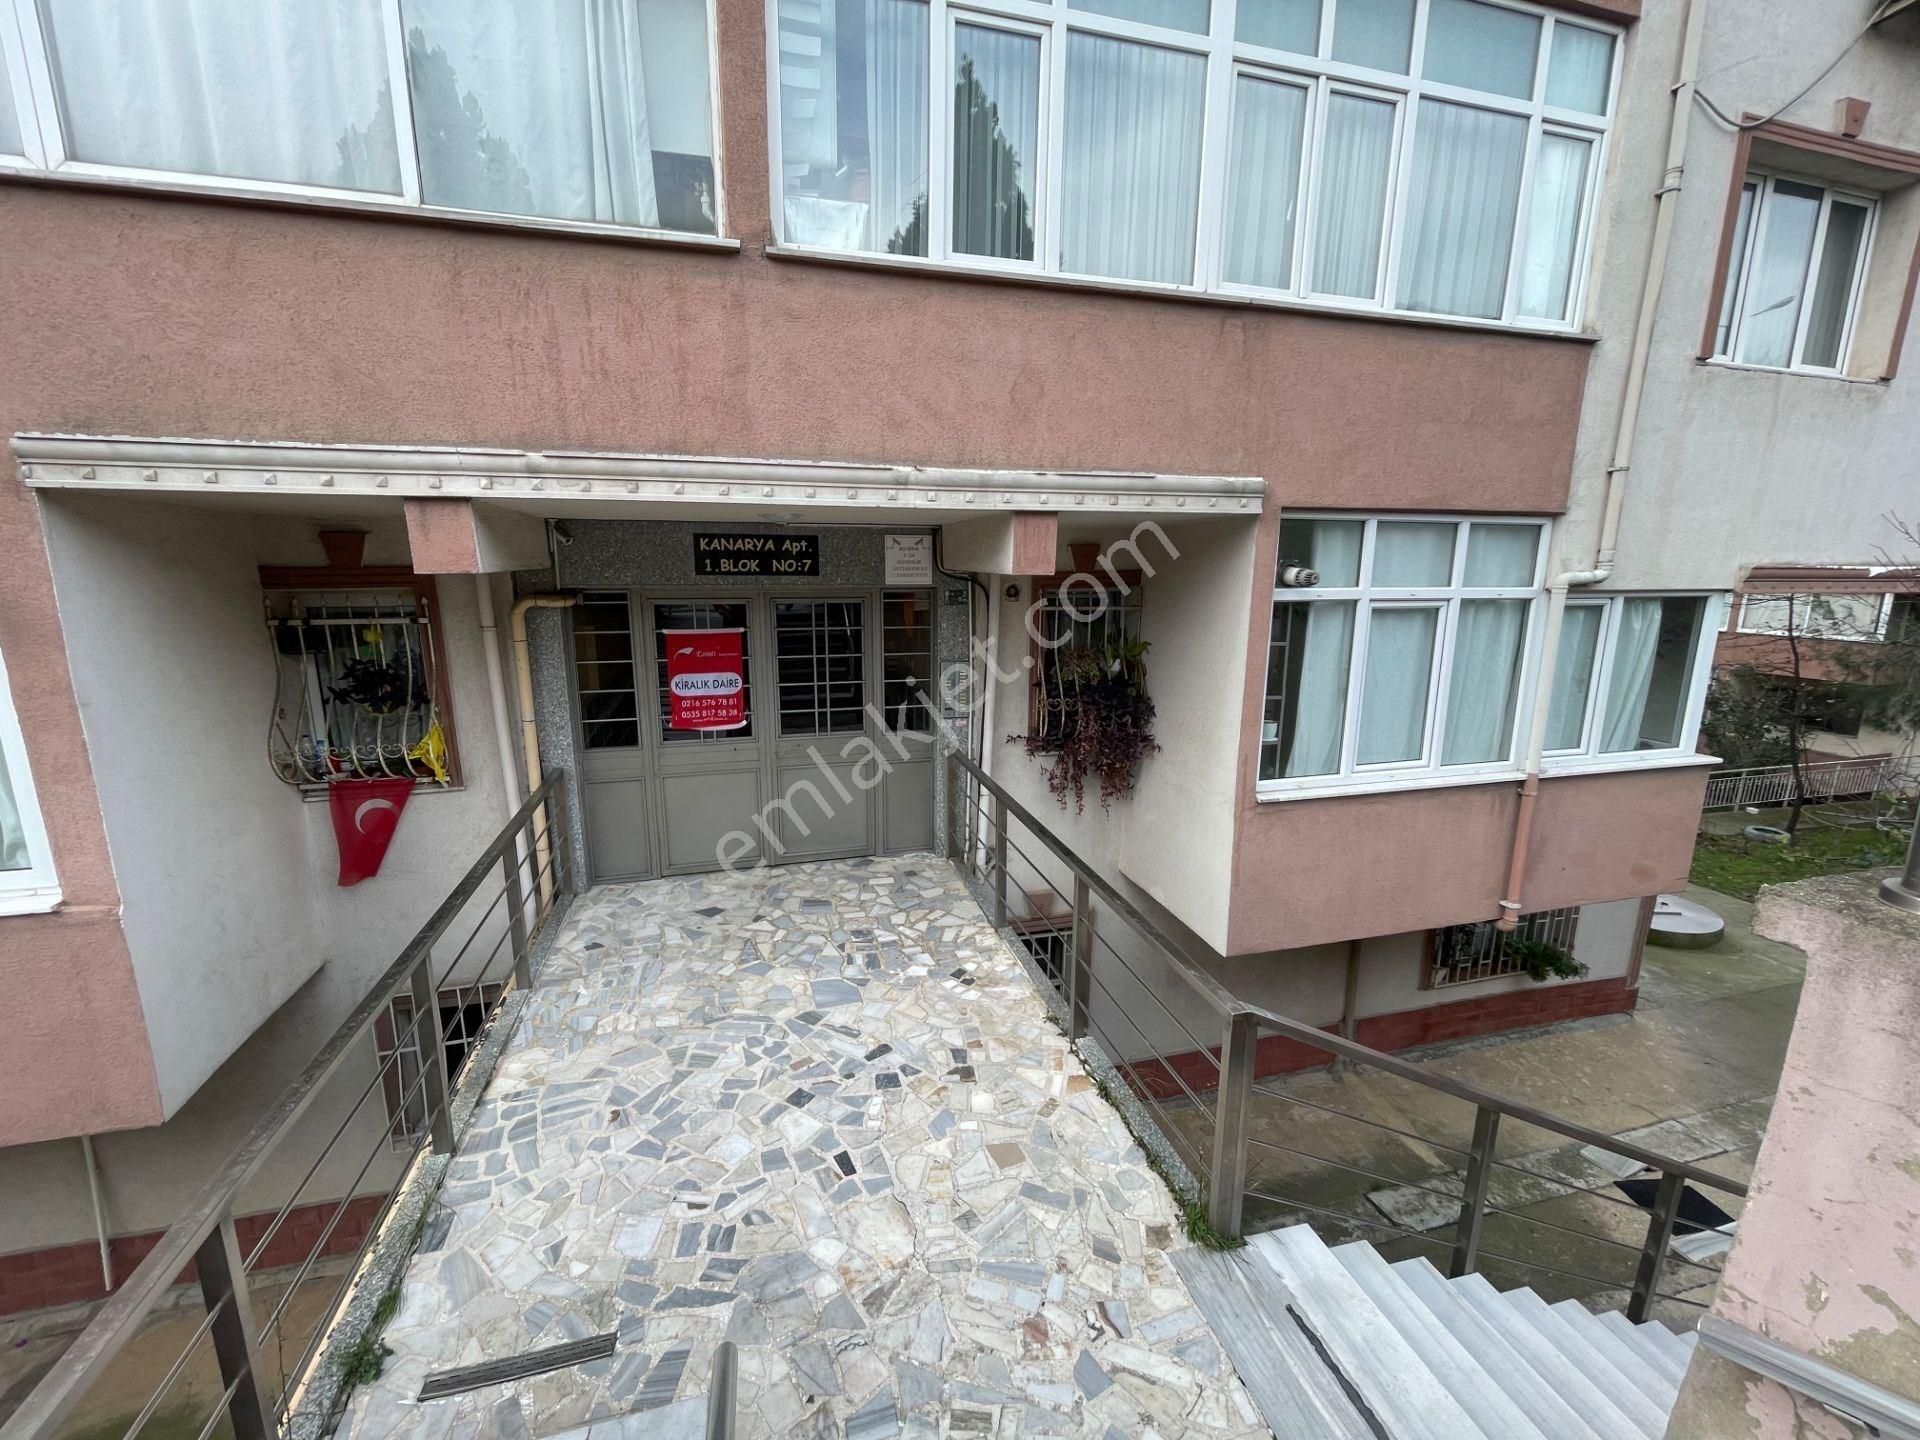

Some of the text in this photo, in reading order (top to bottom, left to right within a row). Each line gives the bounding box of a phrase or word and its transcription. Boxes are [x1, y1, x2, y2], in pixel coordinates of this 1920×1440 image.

[700, 538, 813, 555] KANARYA Apt.
[705, 559, 812, 572] 1.BLOK NO:7
[675, 677, 739, 690] KİRALIK DAİRE
[702, 699, 716, 707] 576
